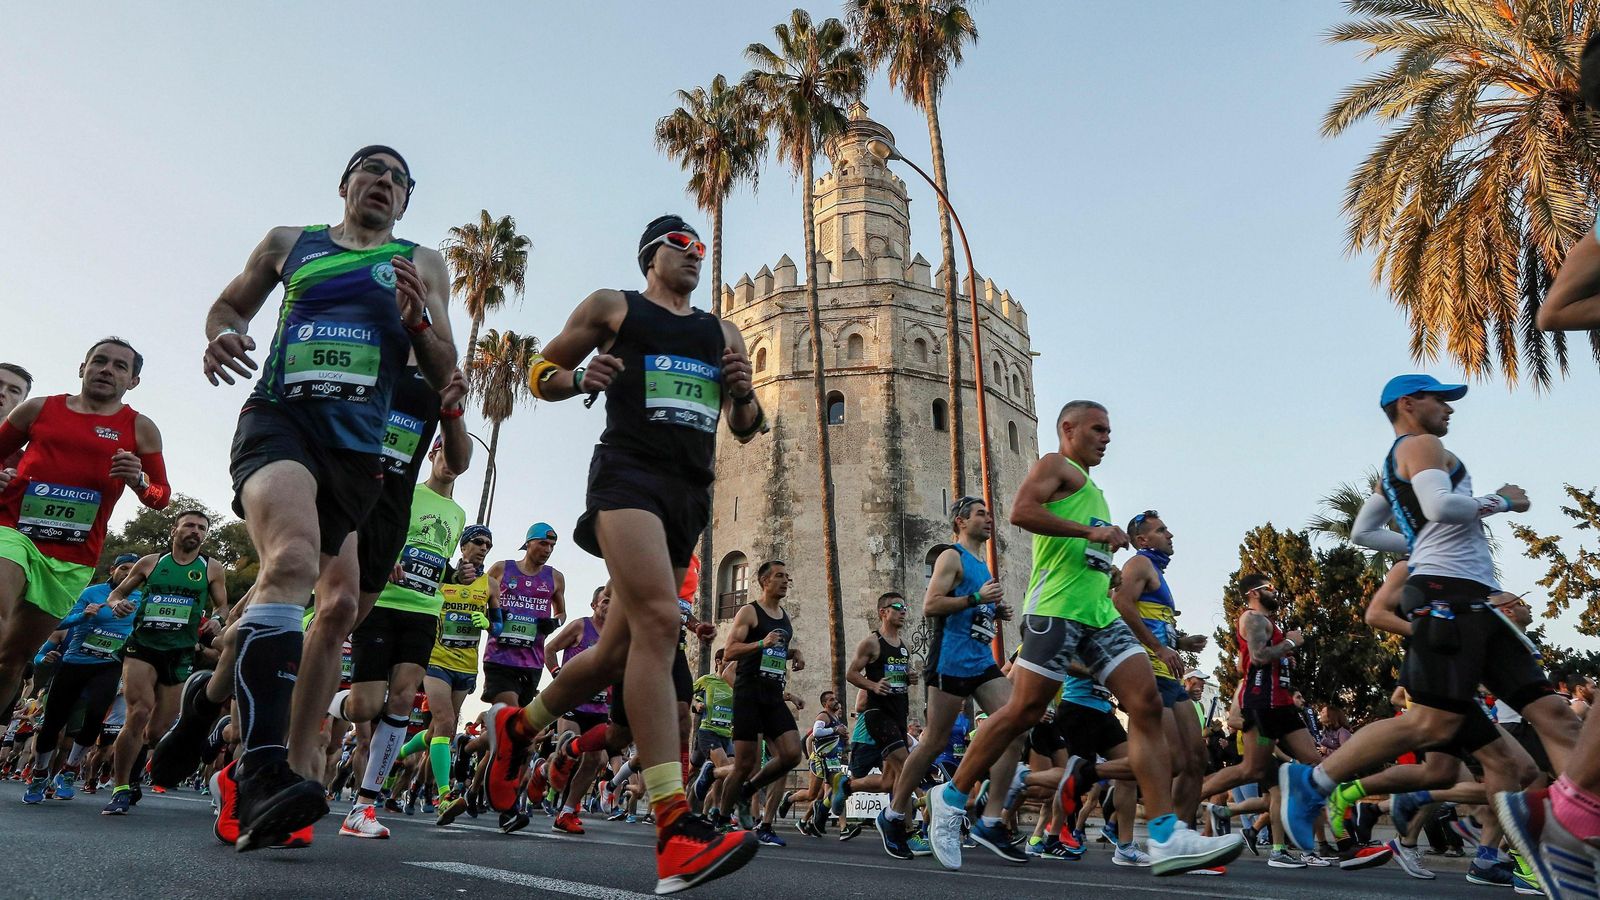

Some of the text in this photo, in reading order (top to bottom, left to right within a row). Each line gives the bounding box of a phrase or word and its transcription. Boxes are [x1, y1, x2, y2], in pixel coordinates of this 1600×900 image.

[316, 326, 371, 340] ZURICH
[312, 349, 351, 367] 565
[674, 360, 714, 378] ZURICH
[673, 380, 702, 399] 773
[51, 488, 94, 501] ZURICH
[44, 504, 76, 519] 876
[419, 551, 443, 564] ZURICH
[411, 562, 434, 578] 1769
[498, 600, 524, 608] PLAYAS
[159, 607, 177, 616] 661
[514, 615, 535, 623] ZURICH
[511, 624, 527, 634] 640
[96, 639, 112, 648] 749
[855, 799, 882, 814] aupa
